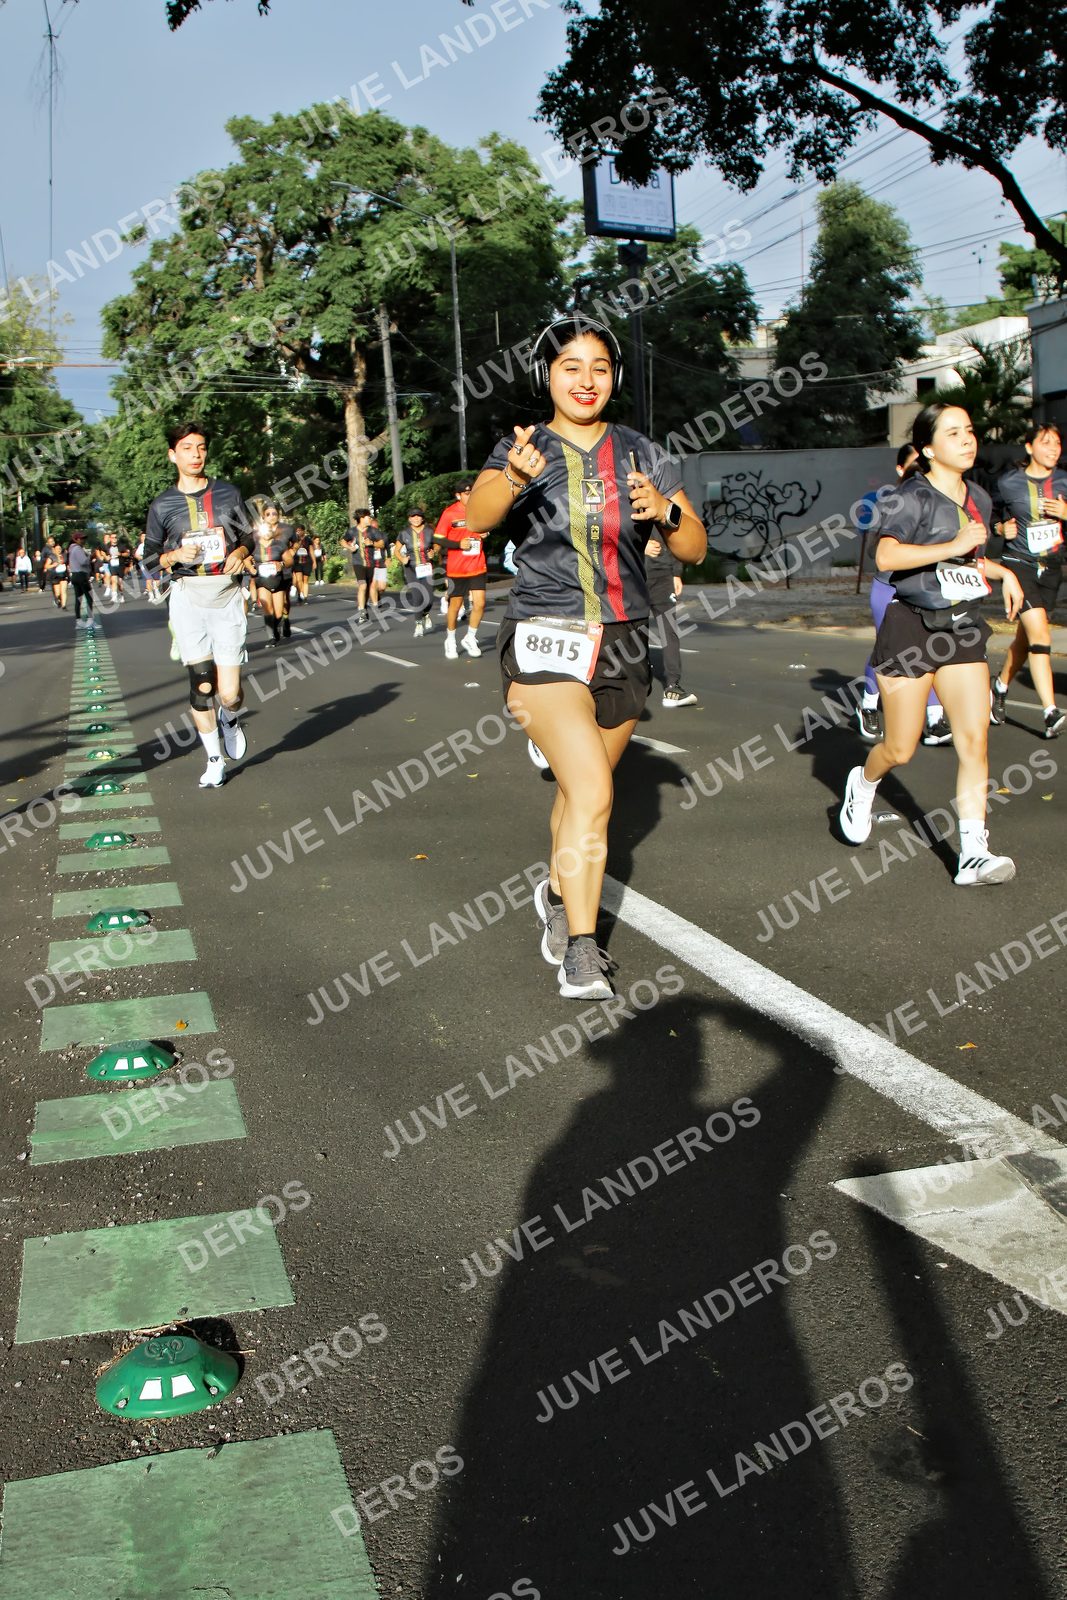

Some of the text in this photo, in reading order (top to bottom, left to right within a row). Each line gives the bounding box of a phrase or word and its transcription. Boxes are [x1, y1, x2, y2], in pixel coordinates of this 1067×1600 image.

[721, 470, 763, 486] TOY
[939, 568, 982, 588] 11043
[525, 633, 581, 662] 8815
